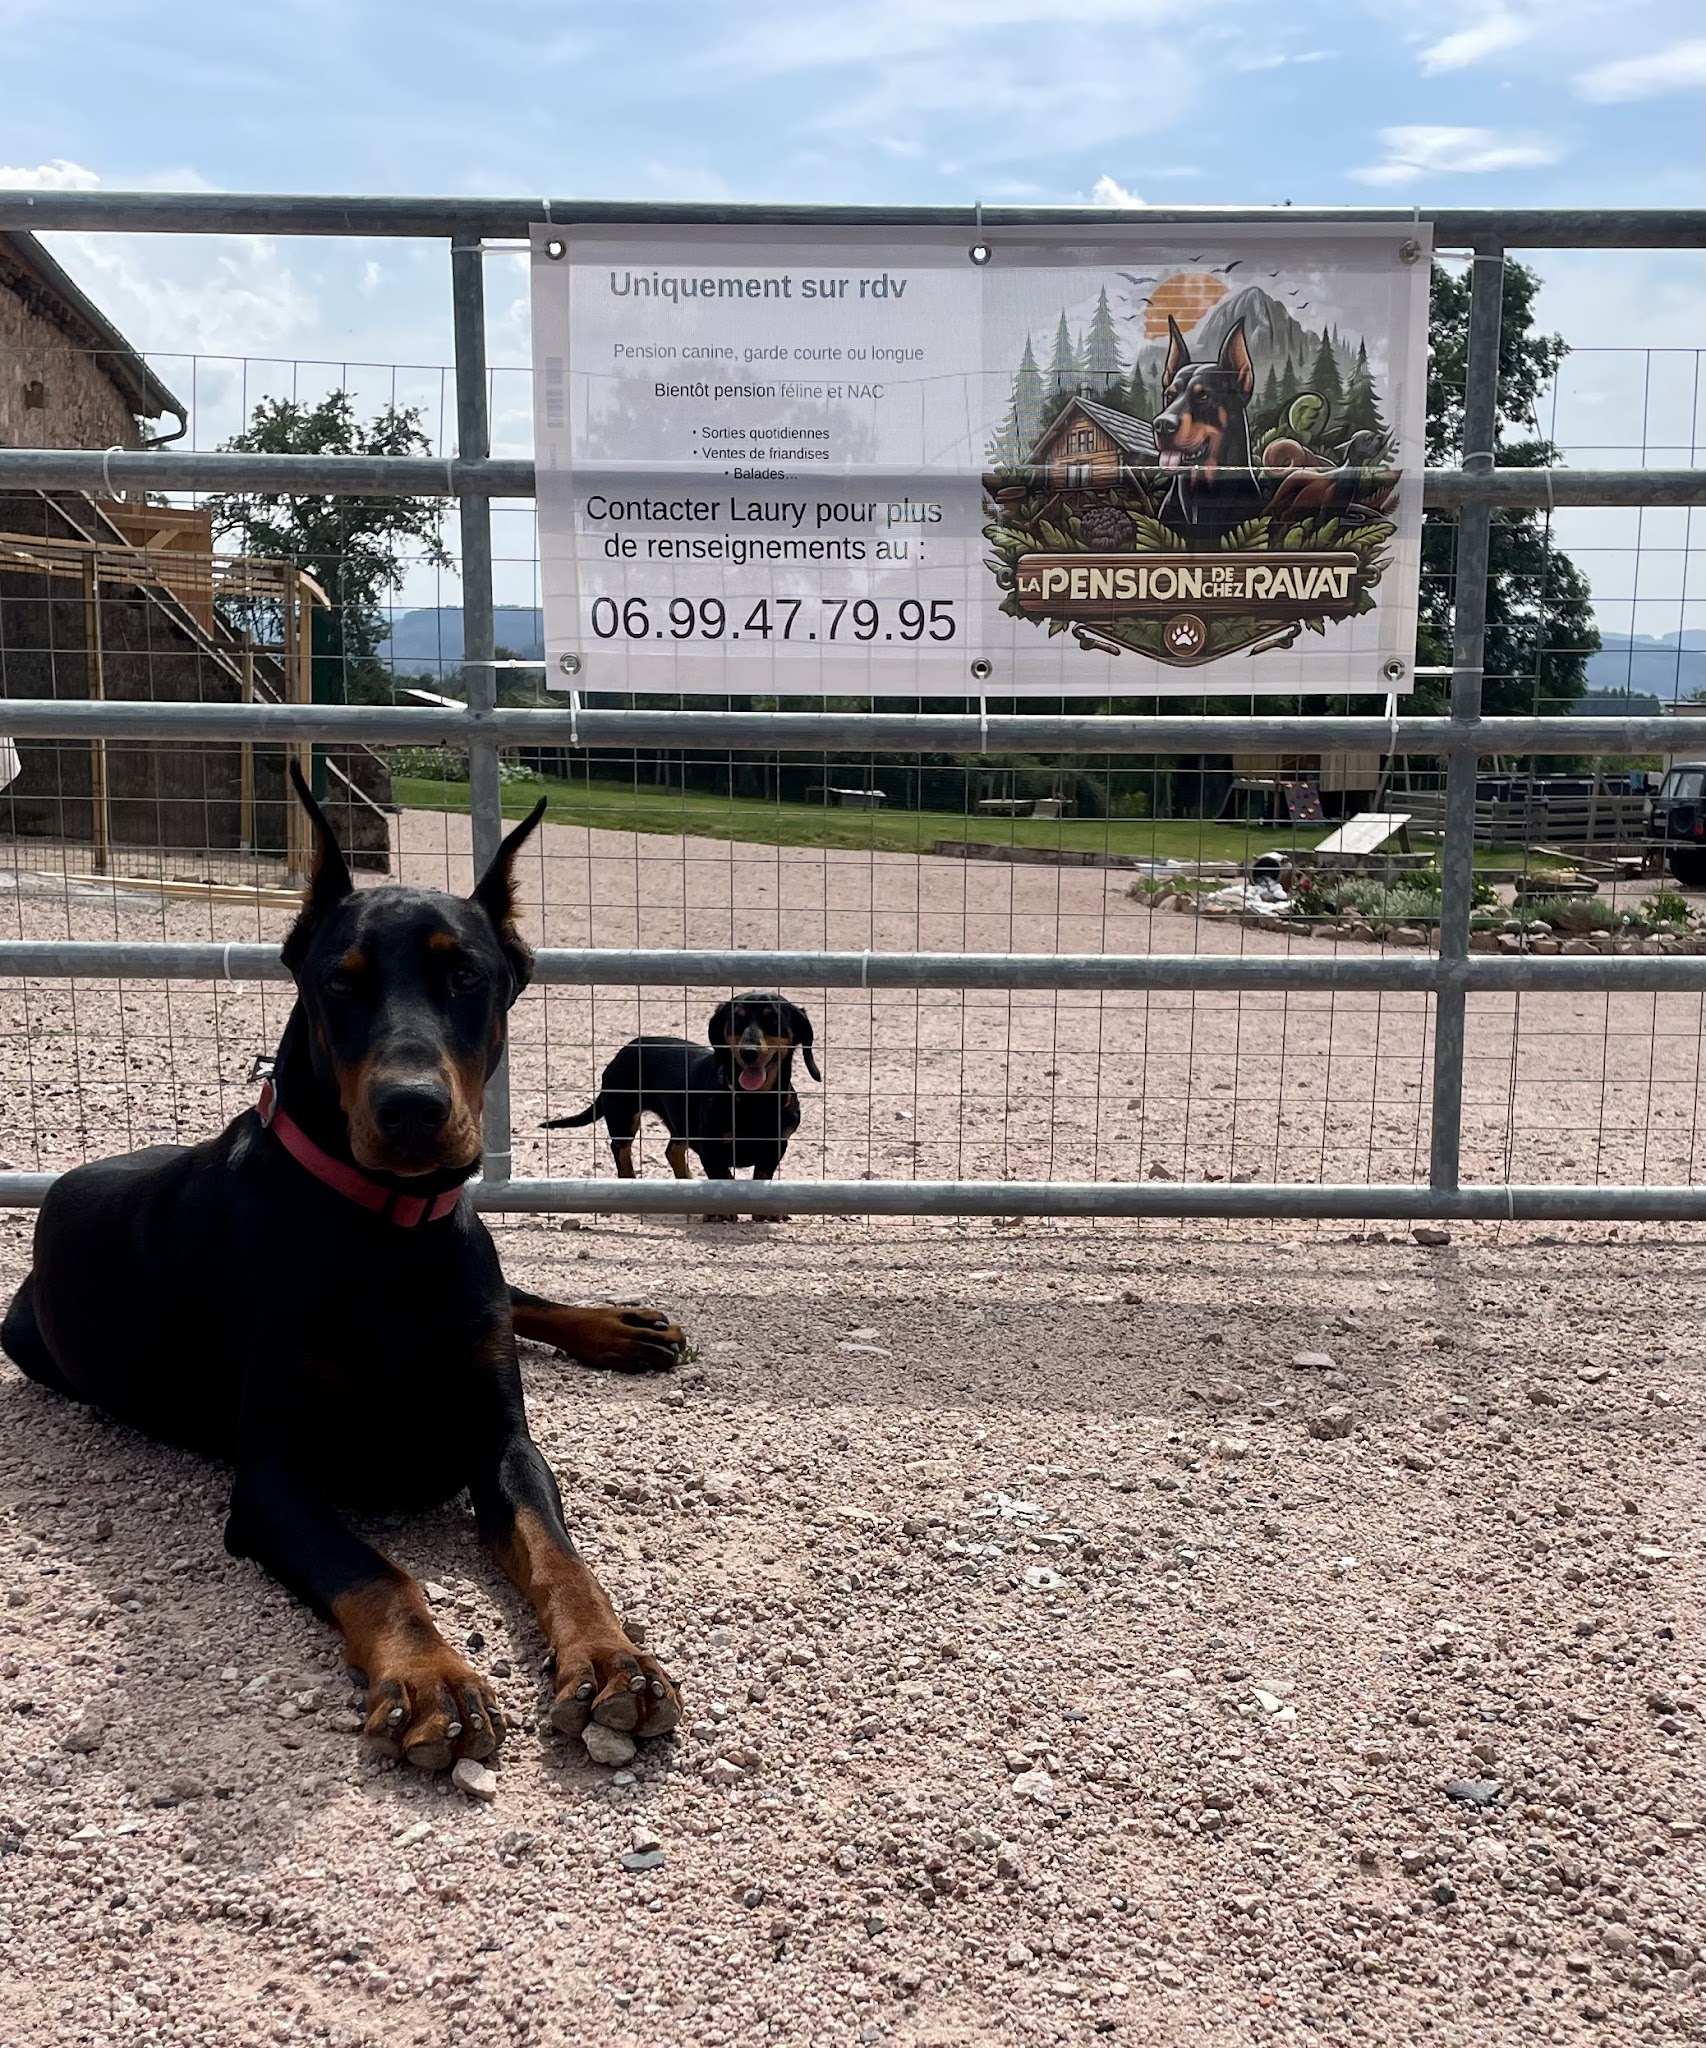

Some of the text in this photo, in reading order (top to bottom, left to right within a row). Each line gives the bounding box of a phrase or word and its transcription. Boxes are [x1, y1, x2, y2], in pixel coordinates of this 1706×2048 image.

[610, 272, 907, 303] Uniquement sur rdv
[614, 344, 924, 365] Pension canine, garde courte ou longue
[655, 383, 885, 401] Bientôt pension féline et NAC
[701, 427, 830, 442] Sorties quotidiennes
[702, 447, 830, 460] Ventes de friandises
[586, 496, 942, 528] Contacter Laury pour plus
[604, 534, 637, 557] de
[648, 535, 866, 565] renseignements
[875, 538, 908, 560] au
[1018, 565, 1357, 600] LA PENSION DE CHEZ RAVAT
[591, 597, 956, 641] 06.99.47.79.95
